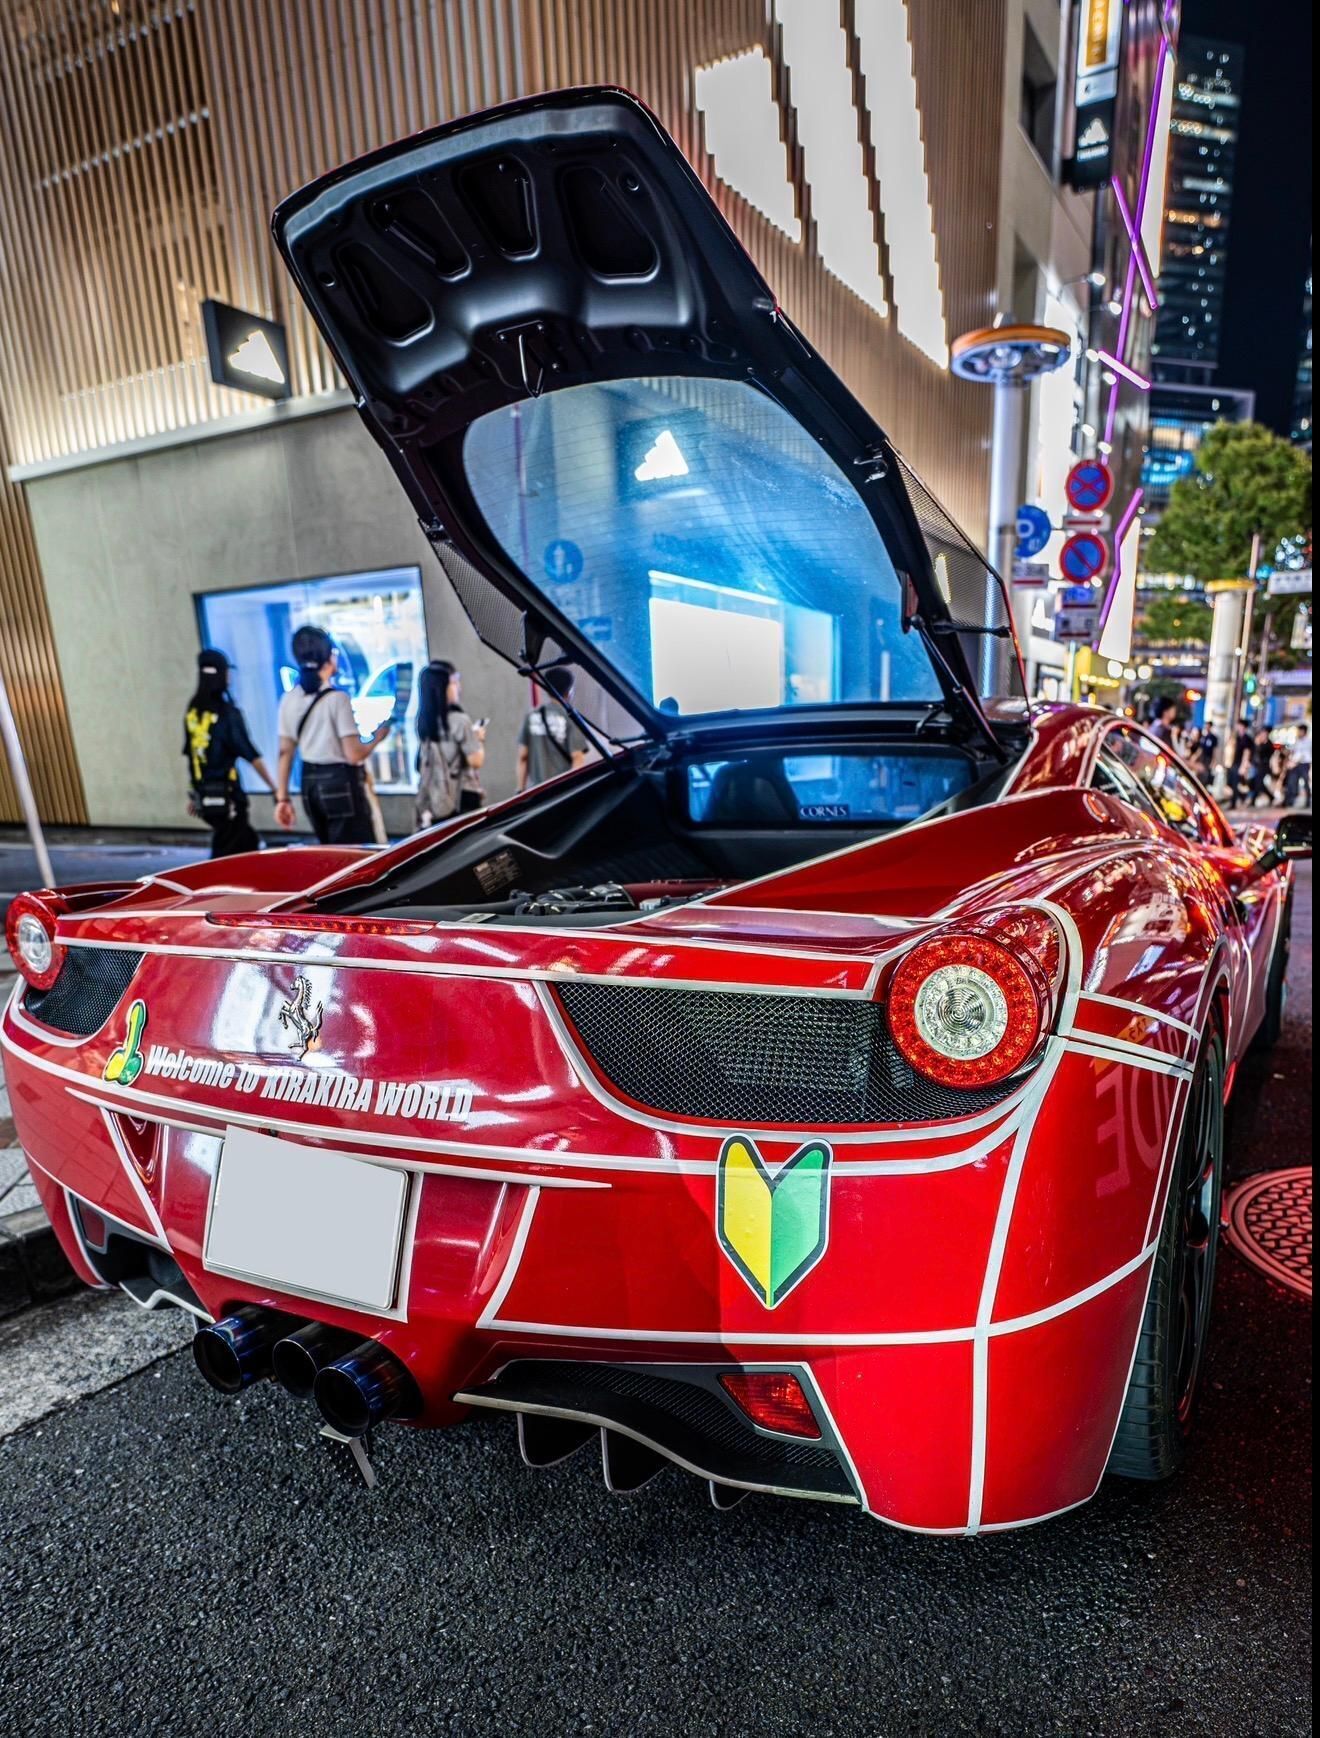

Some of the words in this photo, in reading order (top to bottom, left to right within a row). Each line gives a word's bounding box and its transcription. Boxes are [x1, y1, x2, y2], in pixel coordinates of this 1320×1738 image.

[144, 1044, 236, 1089] Welcome
[235, 1063, 260, 1093] to
[260, 1067, 374, 1112] KIRAKIRA
[374, 1081, 473, 1121] WORLD
